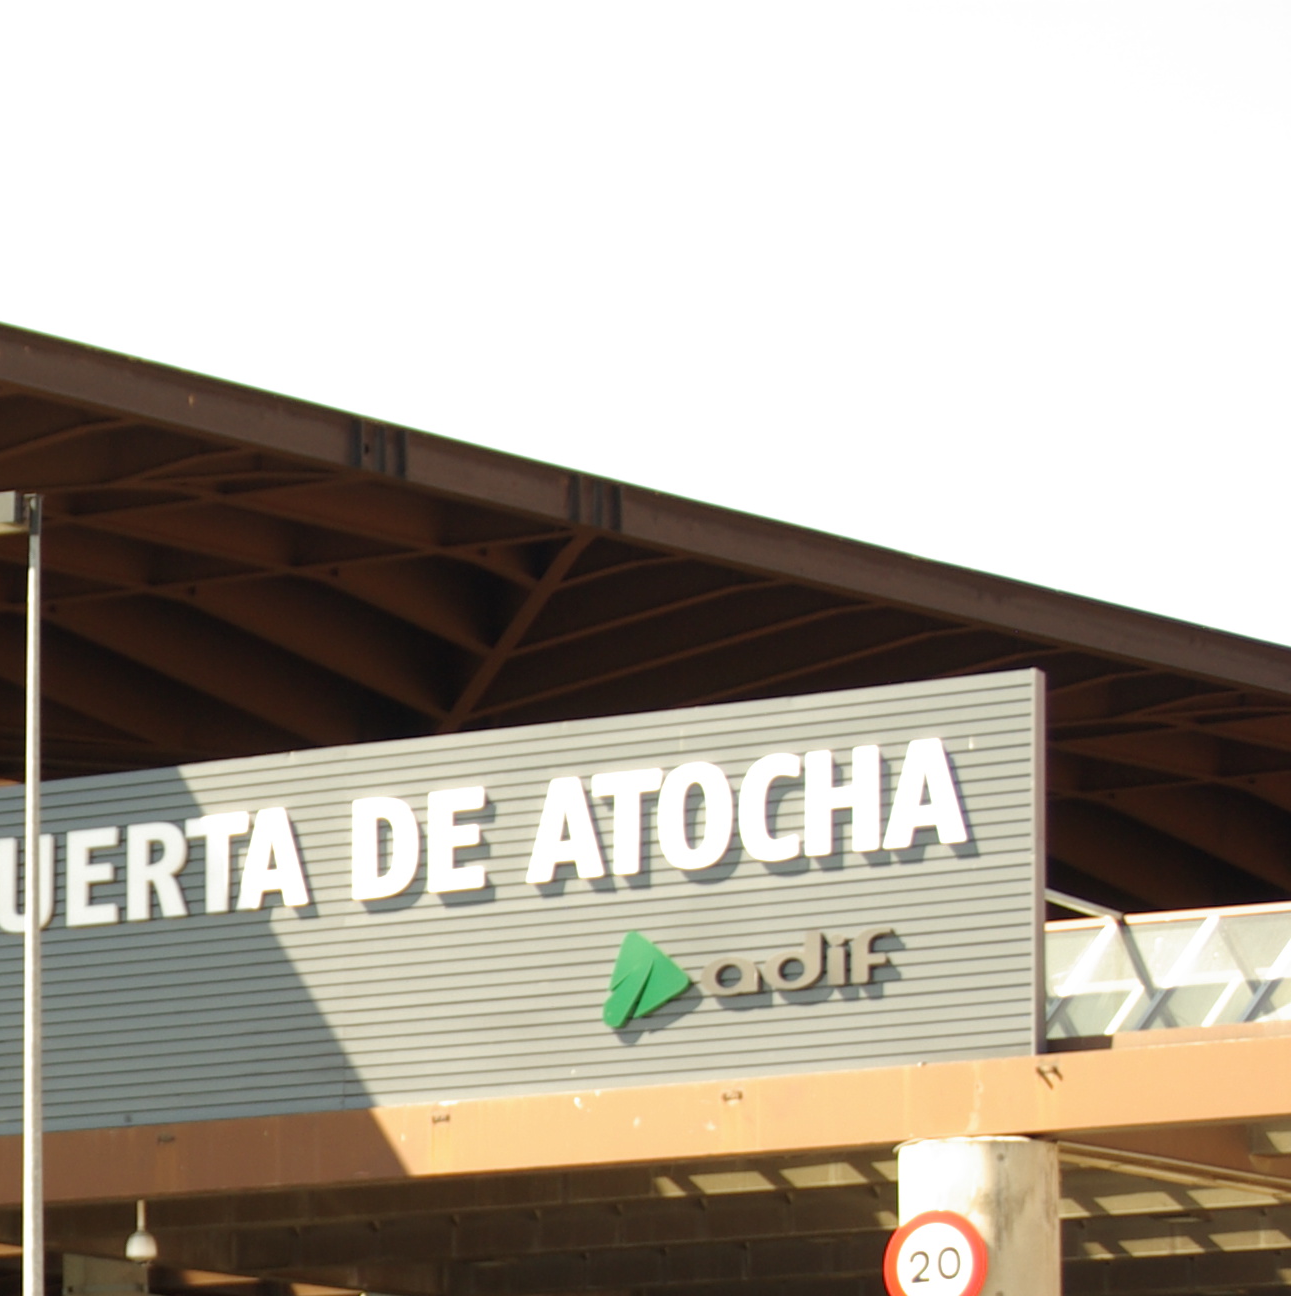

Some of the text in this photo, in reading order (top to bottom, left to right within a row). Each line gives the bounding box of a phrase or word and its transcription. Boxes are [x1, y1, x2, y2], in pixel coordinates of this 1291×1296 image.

[351, 785, 487, 901] DE
[525, 736, 969, 885] ATOCHA
[700, 927, 895, 997] adif
[909, 1246, 961, 1284] 20
